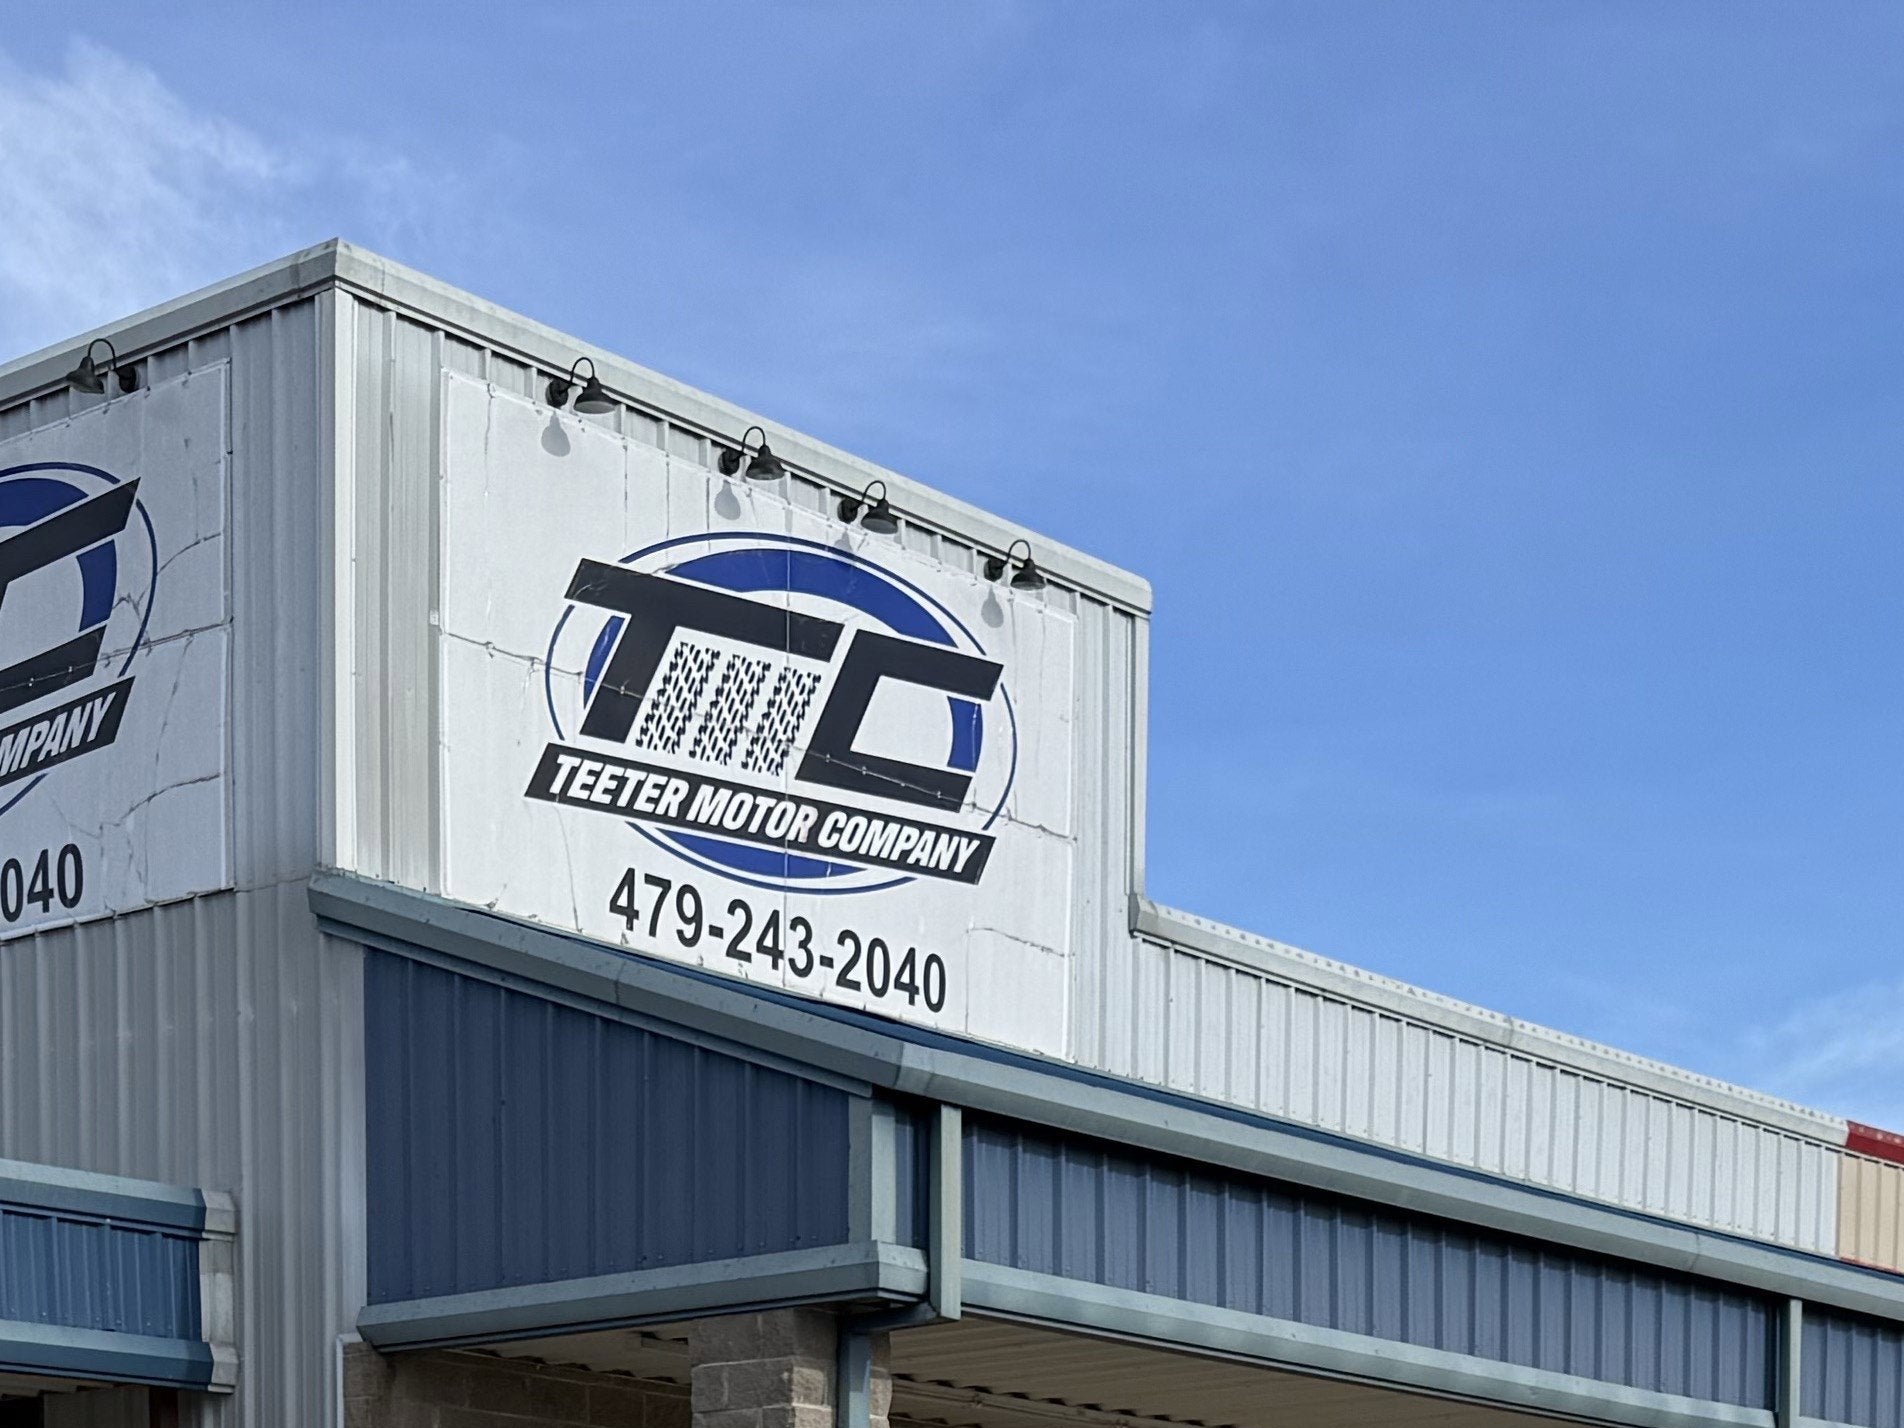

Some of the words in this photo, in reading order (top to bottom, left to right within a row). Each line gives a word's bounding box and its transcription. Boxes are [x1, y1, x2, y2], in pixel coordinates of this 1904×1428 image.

[549, 754, 689, 818] TEETER
[686, 782, 819, 843] MOTOR
[818, 811, 981, 874] COMPANY
[609, 867, 947, 1013] 479-243-2040
